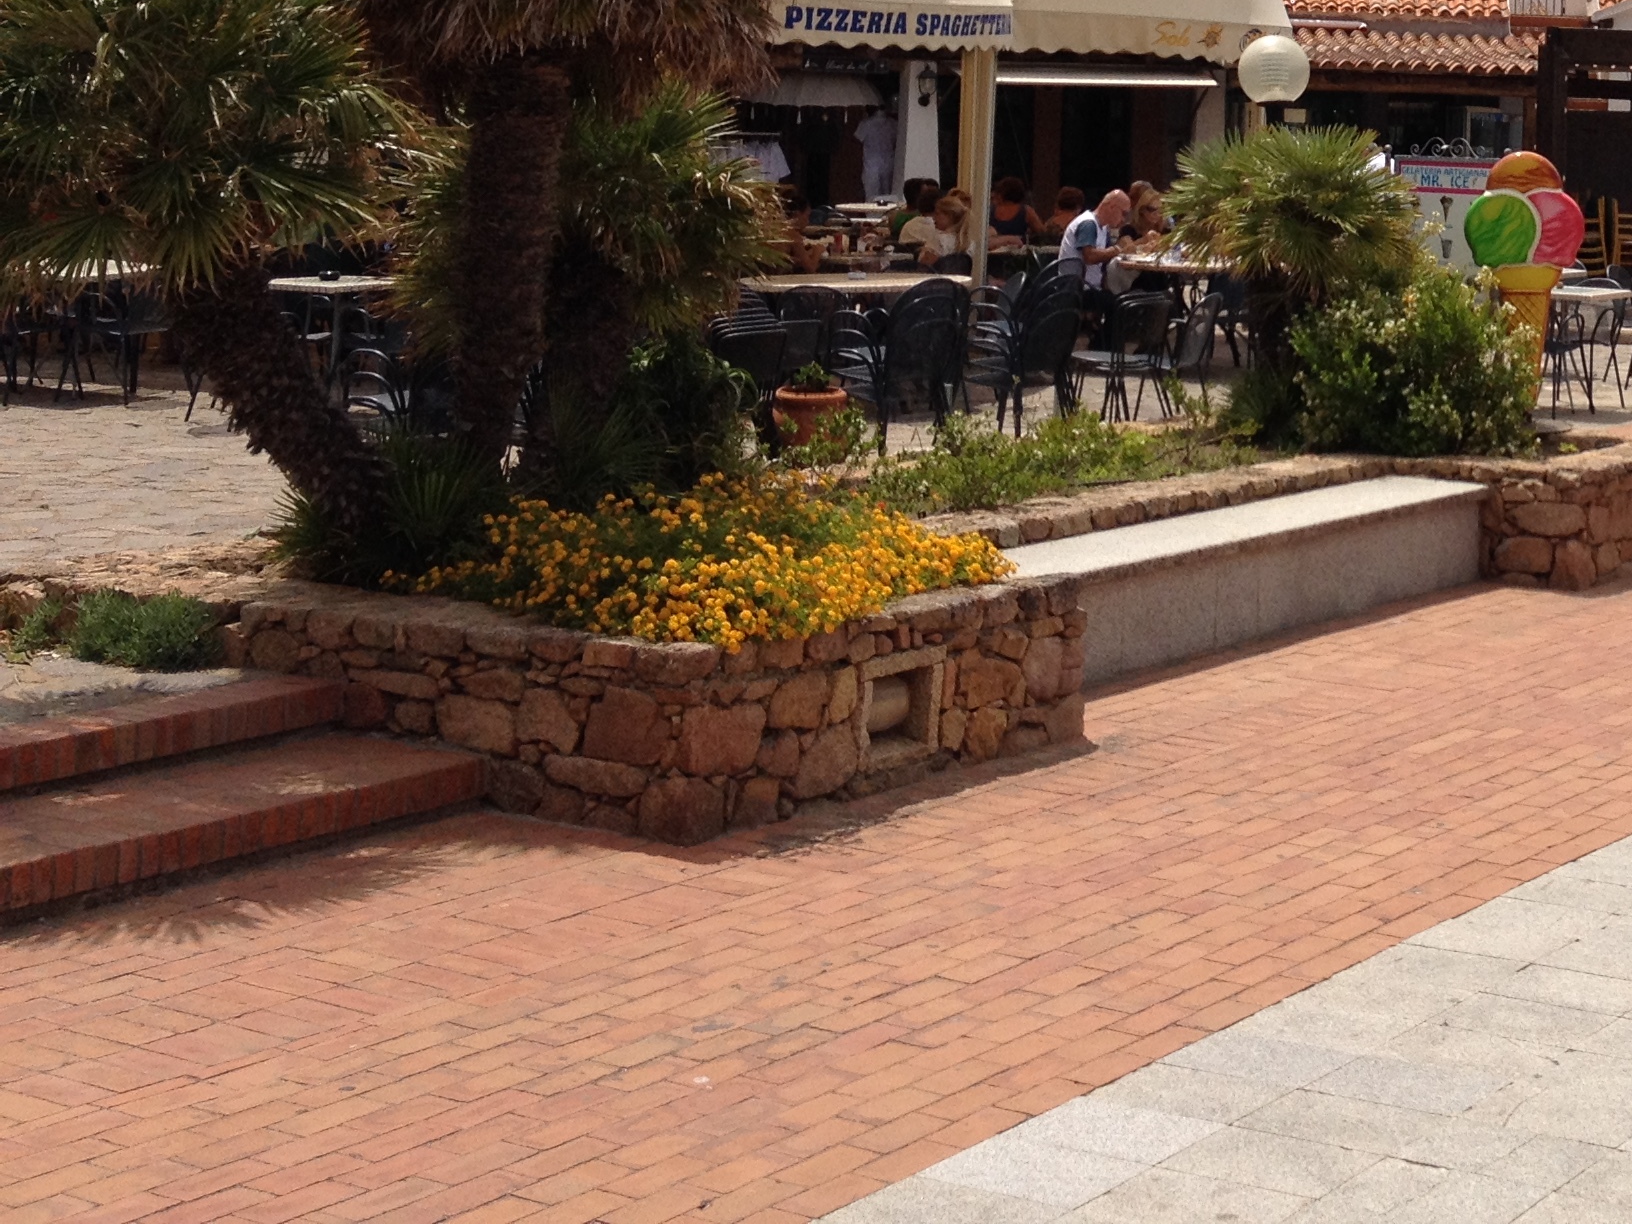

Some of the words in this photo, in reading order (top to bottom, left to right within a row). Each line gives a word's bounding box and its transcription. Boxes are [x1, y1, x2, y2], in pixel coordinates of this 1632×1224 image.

[784, 5, 907, 35] PIZZERIA
[1420, 175, 1443, 187] MR.
[1450, 177, 1470, 188] ICE
